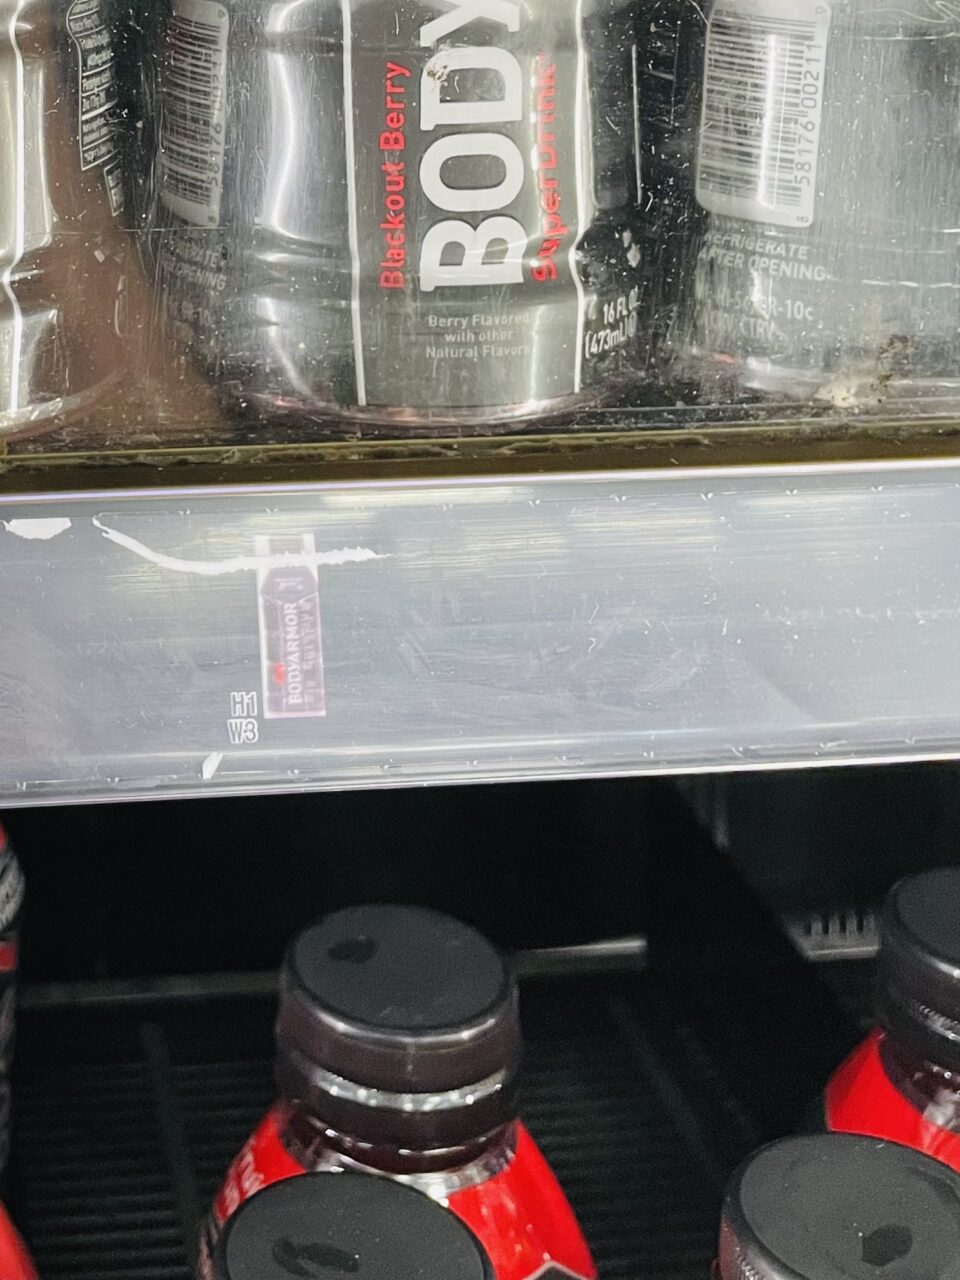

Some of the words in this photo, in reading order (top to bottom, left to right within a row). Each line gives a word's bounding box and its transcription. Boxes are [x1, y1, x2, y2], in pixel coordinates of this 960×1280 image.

[800, 43, 823, 109] 00211
[379, 61, 411, 151] Berry
[794, 120, 816, 186] 58176
[379, 161, 407, 289] Blackout
[428, 315, 468, 329] Berry
[472, 312, 530, 327] Flavored
[444, 329, 475, 342] with
[478, 329, 513, 341] other
[603, 301, 615, 325] 16
[426, 345, 478, 359] Natural
